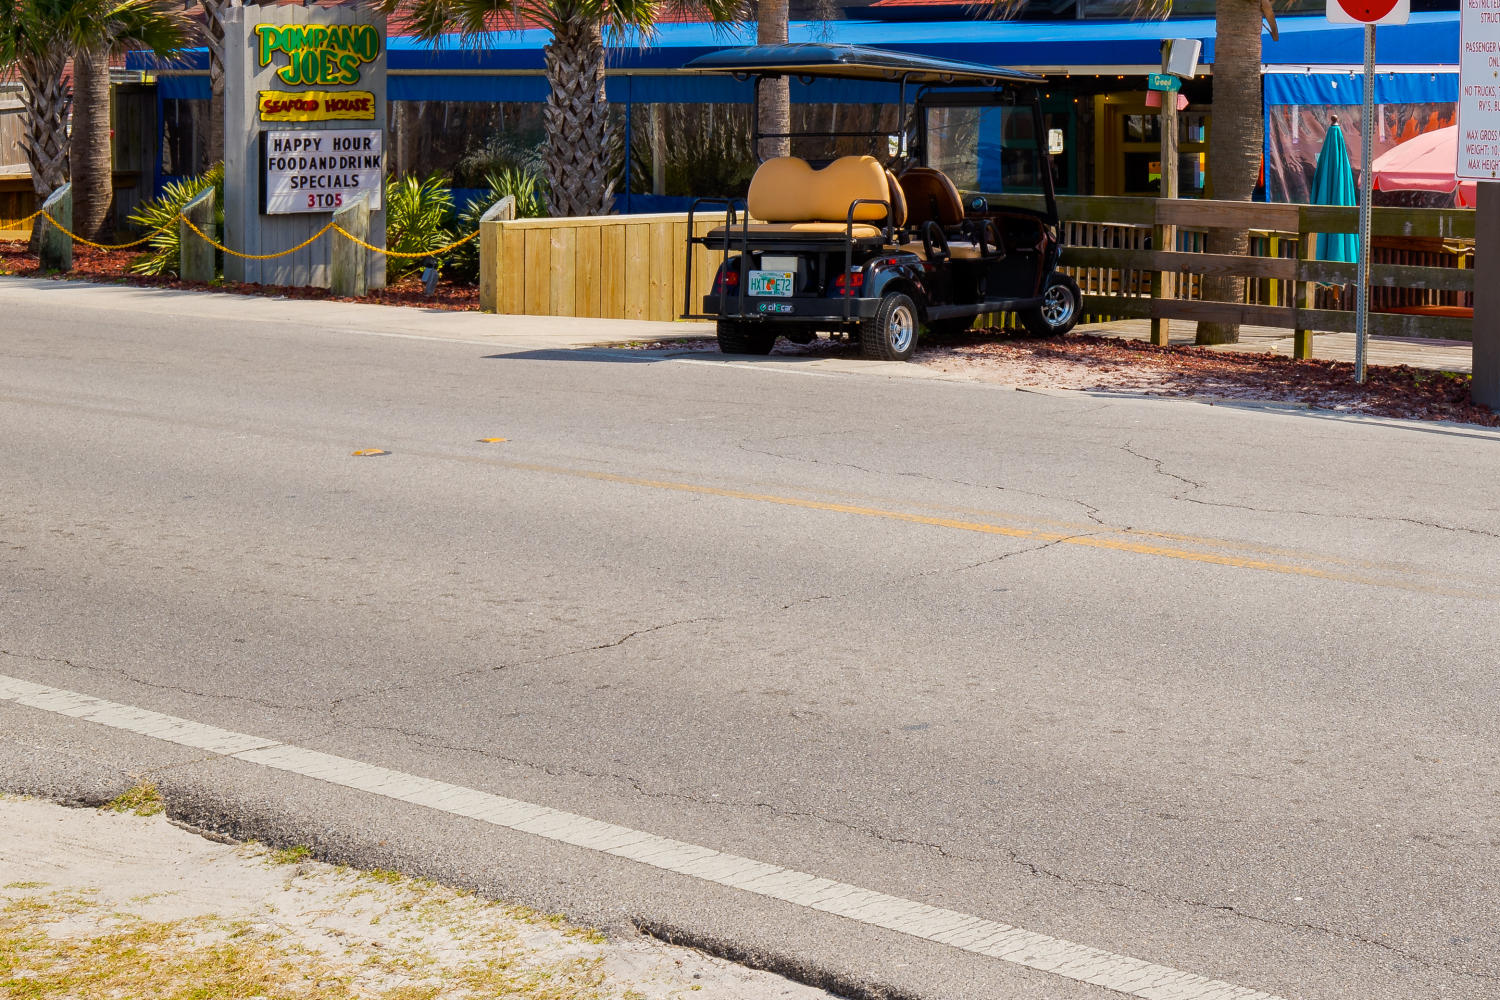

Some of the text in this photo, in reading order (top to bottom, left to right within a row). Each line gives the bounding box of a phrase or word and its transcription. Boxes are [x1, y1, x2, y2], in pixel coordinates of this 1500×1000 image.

[257, 25, 379, 65] POMPANO
[1465, 42, 1496, 52] PASSENGER
[279, 50, 360, 84] JOES
[1465, 86, 1472, 96] NO
[1474, 86, 1496, 98] TRUCKS,
[264, 98, 371, 113] SEAFOOD HOUSE
[1466, 130, 1479, 140] MAX
[1480, 130, 1497, 141] GROSS
[274, 137, 371, 152] HAPPY HOUR
[1466, 144, 1489, 155] WEIGHT:
[1468, 159, 1480, 170] MAX
[290, 174, 359, 189] SPECIALS
